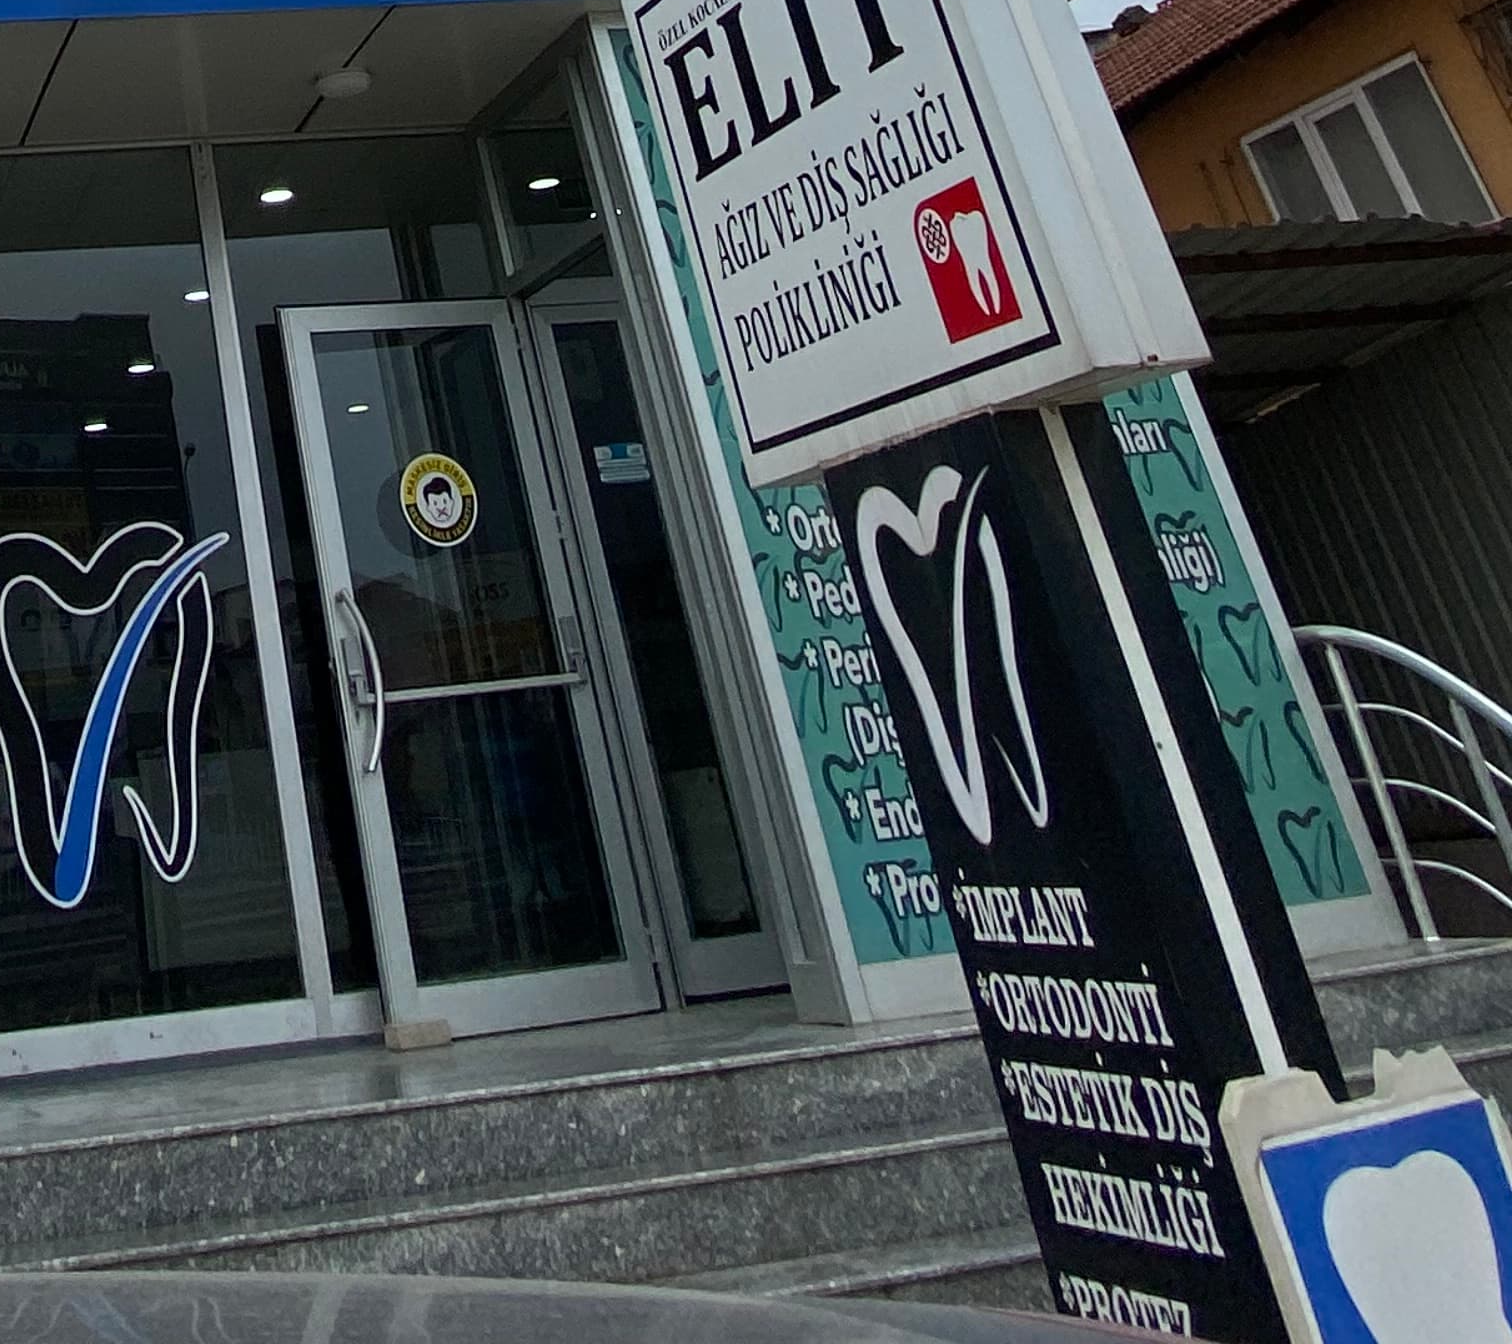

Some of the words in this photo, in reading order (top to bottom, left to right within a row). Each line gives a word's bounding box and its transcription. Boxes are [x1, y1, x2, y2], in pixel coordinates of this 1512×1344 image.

[657, 20, 688, 51] ÖZEL
[714, 194, 765, 280] AĞIZ
[764, 182, 806, 258] VE
[800, 150, 850, 235] DİŞ
[846, 81, 966, 208] SAĞLIĞI
[733, 228, 903, 373] POLİKLİNİĞİ
[1112, 408, 1167, 454] ları
[886, 864, 940, 916] Pro
[1140, 1059, 1214, 1169] DİŞ
[1040, 1152, 1226, 1258] HEKİMLİĞİ
